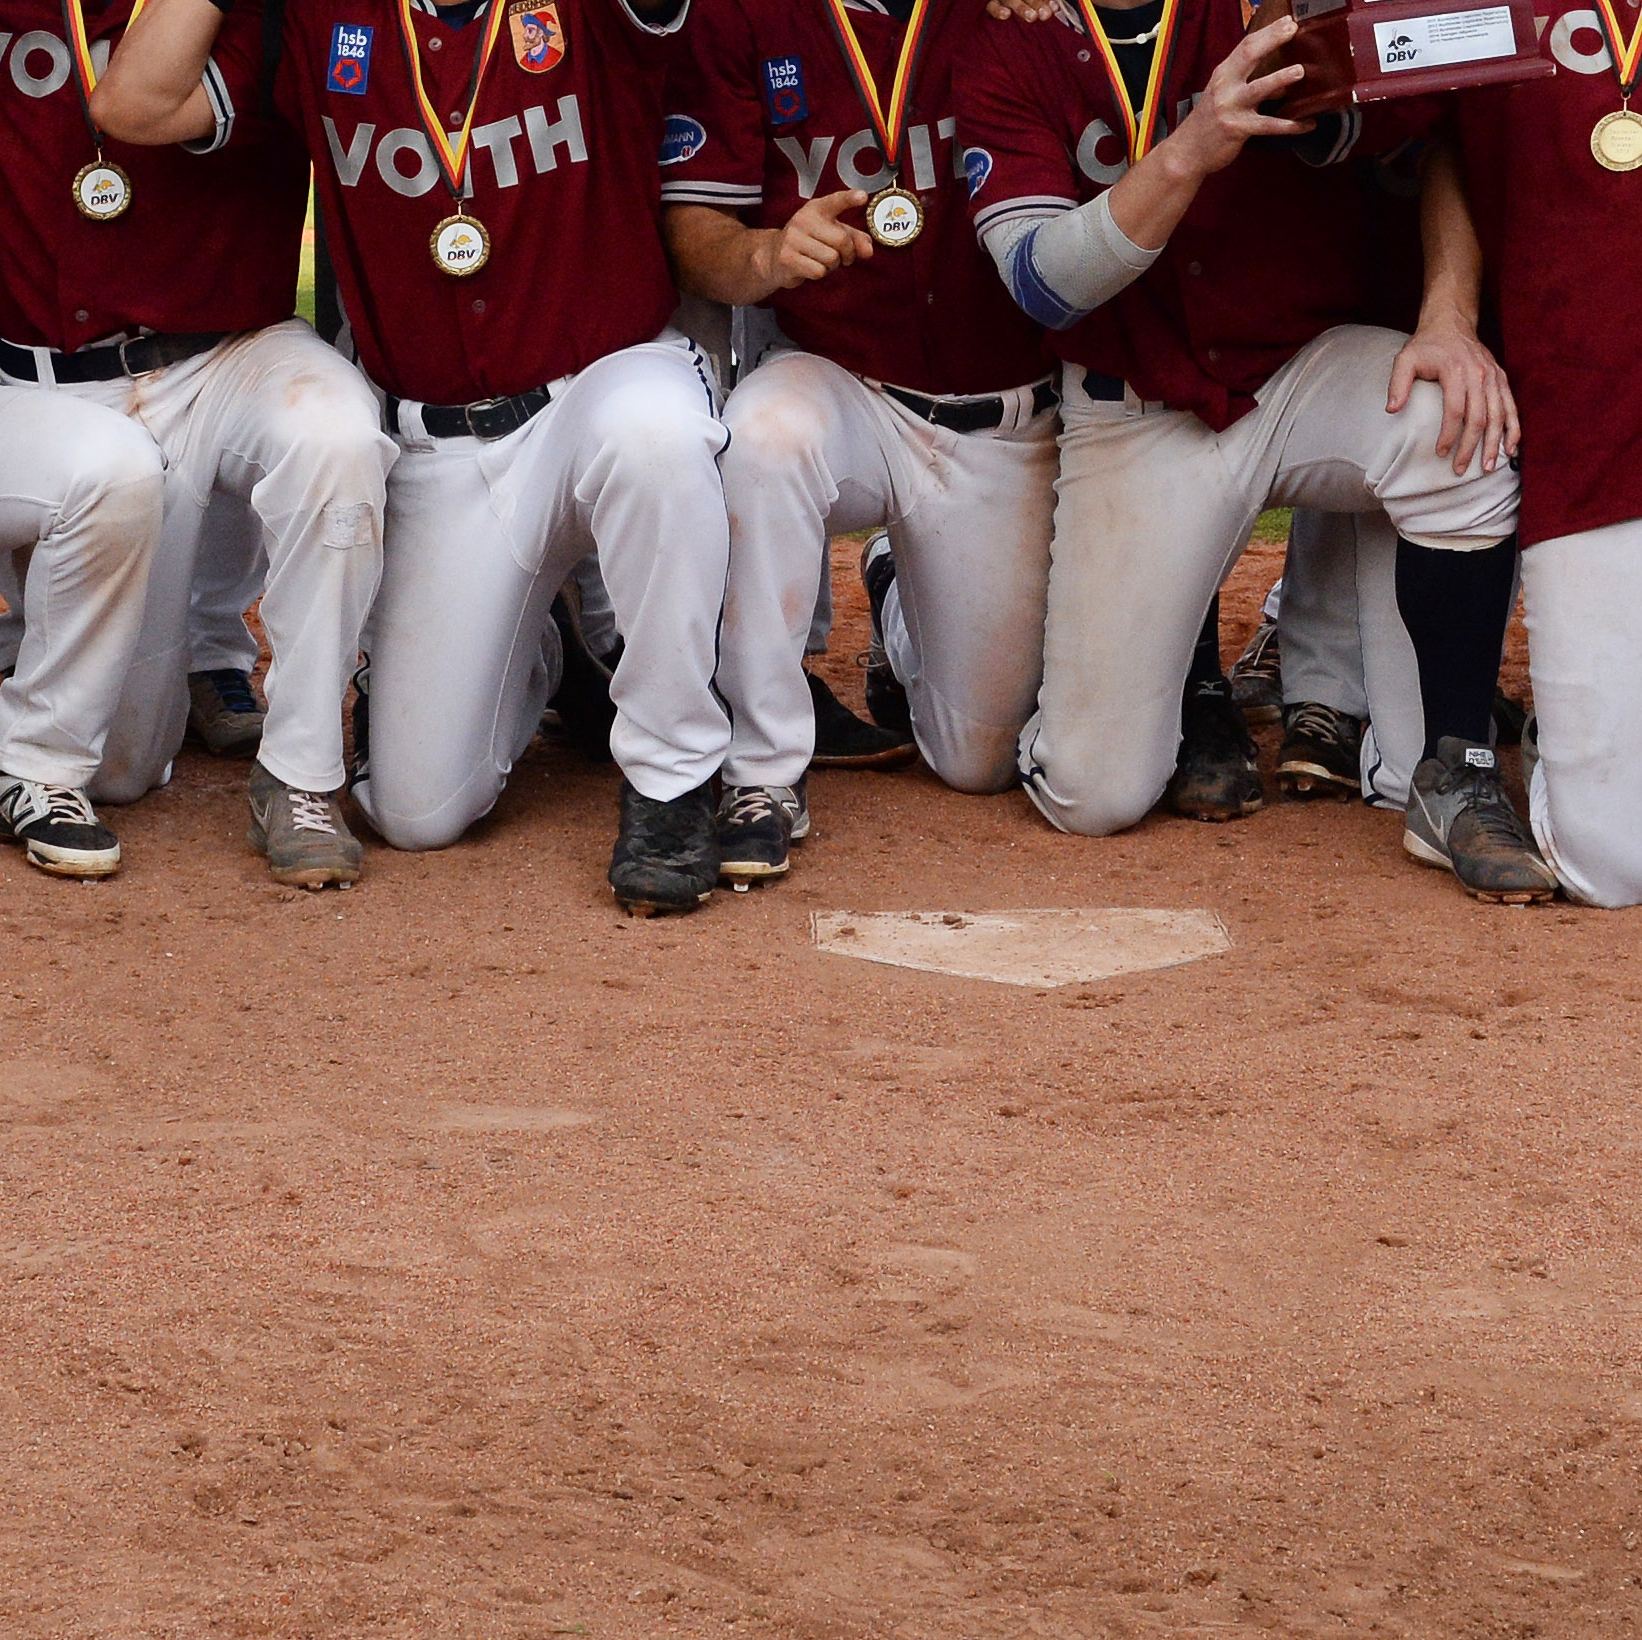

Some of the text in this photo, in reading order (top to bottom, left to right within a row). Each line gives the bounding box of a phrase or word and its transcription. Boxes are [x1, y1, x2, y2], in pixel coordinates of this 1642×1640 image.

[338, 26, 367, 47] hsb
[336, 44, 365, 58] 1846
[1387, 48, 1417, 63] DBV
[768, 60, 796, 78] hsb
[770, 74, 798, 89] 1846
[89, 194, 118, 206] DBV
[883, 220, 910, 234] DBV
[447, 248, 476, 261] DBV
